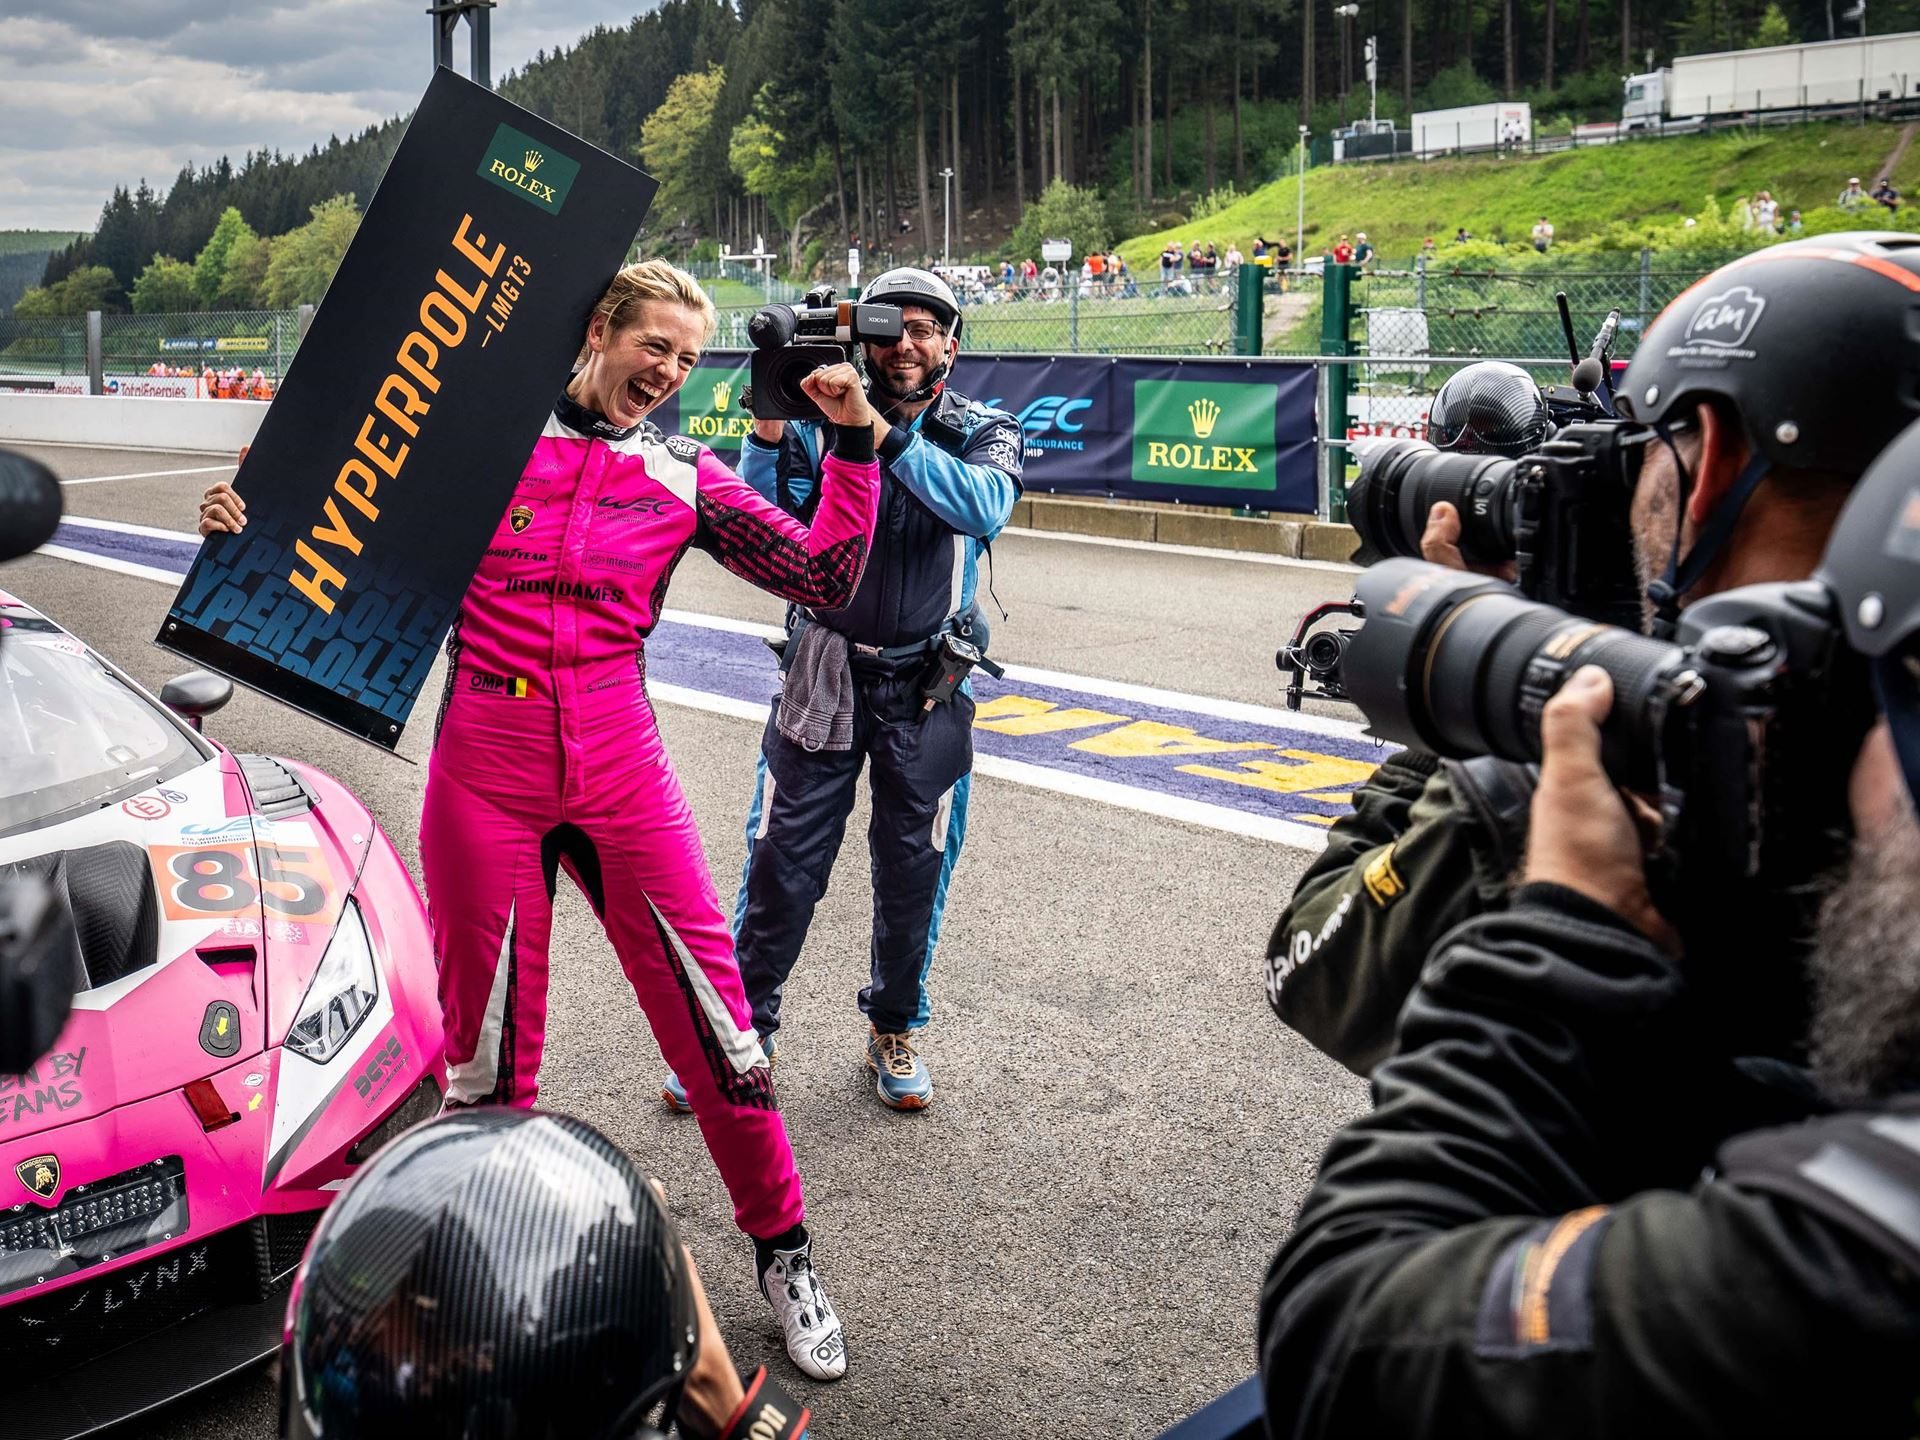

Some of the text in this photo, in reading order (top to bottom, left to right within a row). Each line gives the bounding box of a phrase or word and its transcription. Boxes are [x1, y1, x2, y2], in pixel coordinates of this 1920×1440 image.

[489, 159, 557, 203] ROLEX
[288, 213, 507, 615] HYPERPOLE
[688, 416, 754, 437] ROLEX
[1147, 442, 1259, 473] ROLEX
[606, 554, 645, 571] intensum
[505, 577, 625, 604] IRON DAMES
[470, 673, 505, 690] OMP
[166, 846, 326, 916] 85
[48, 1046, 87, 1079] BY
